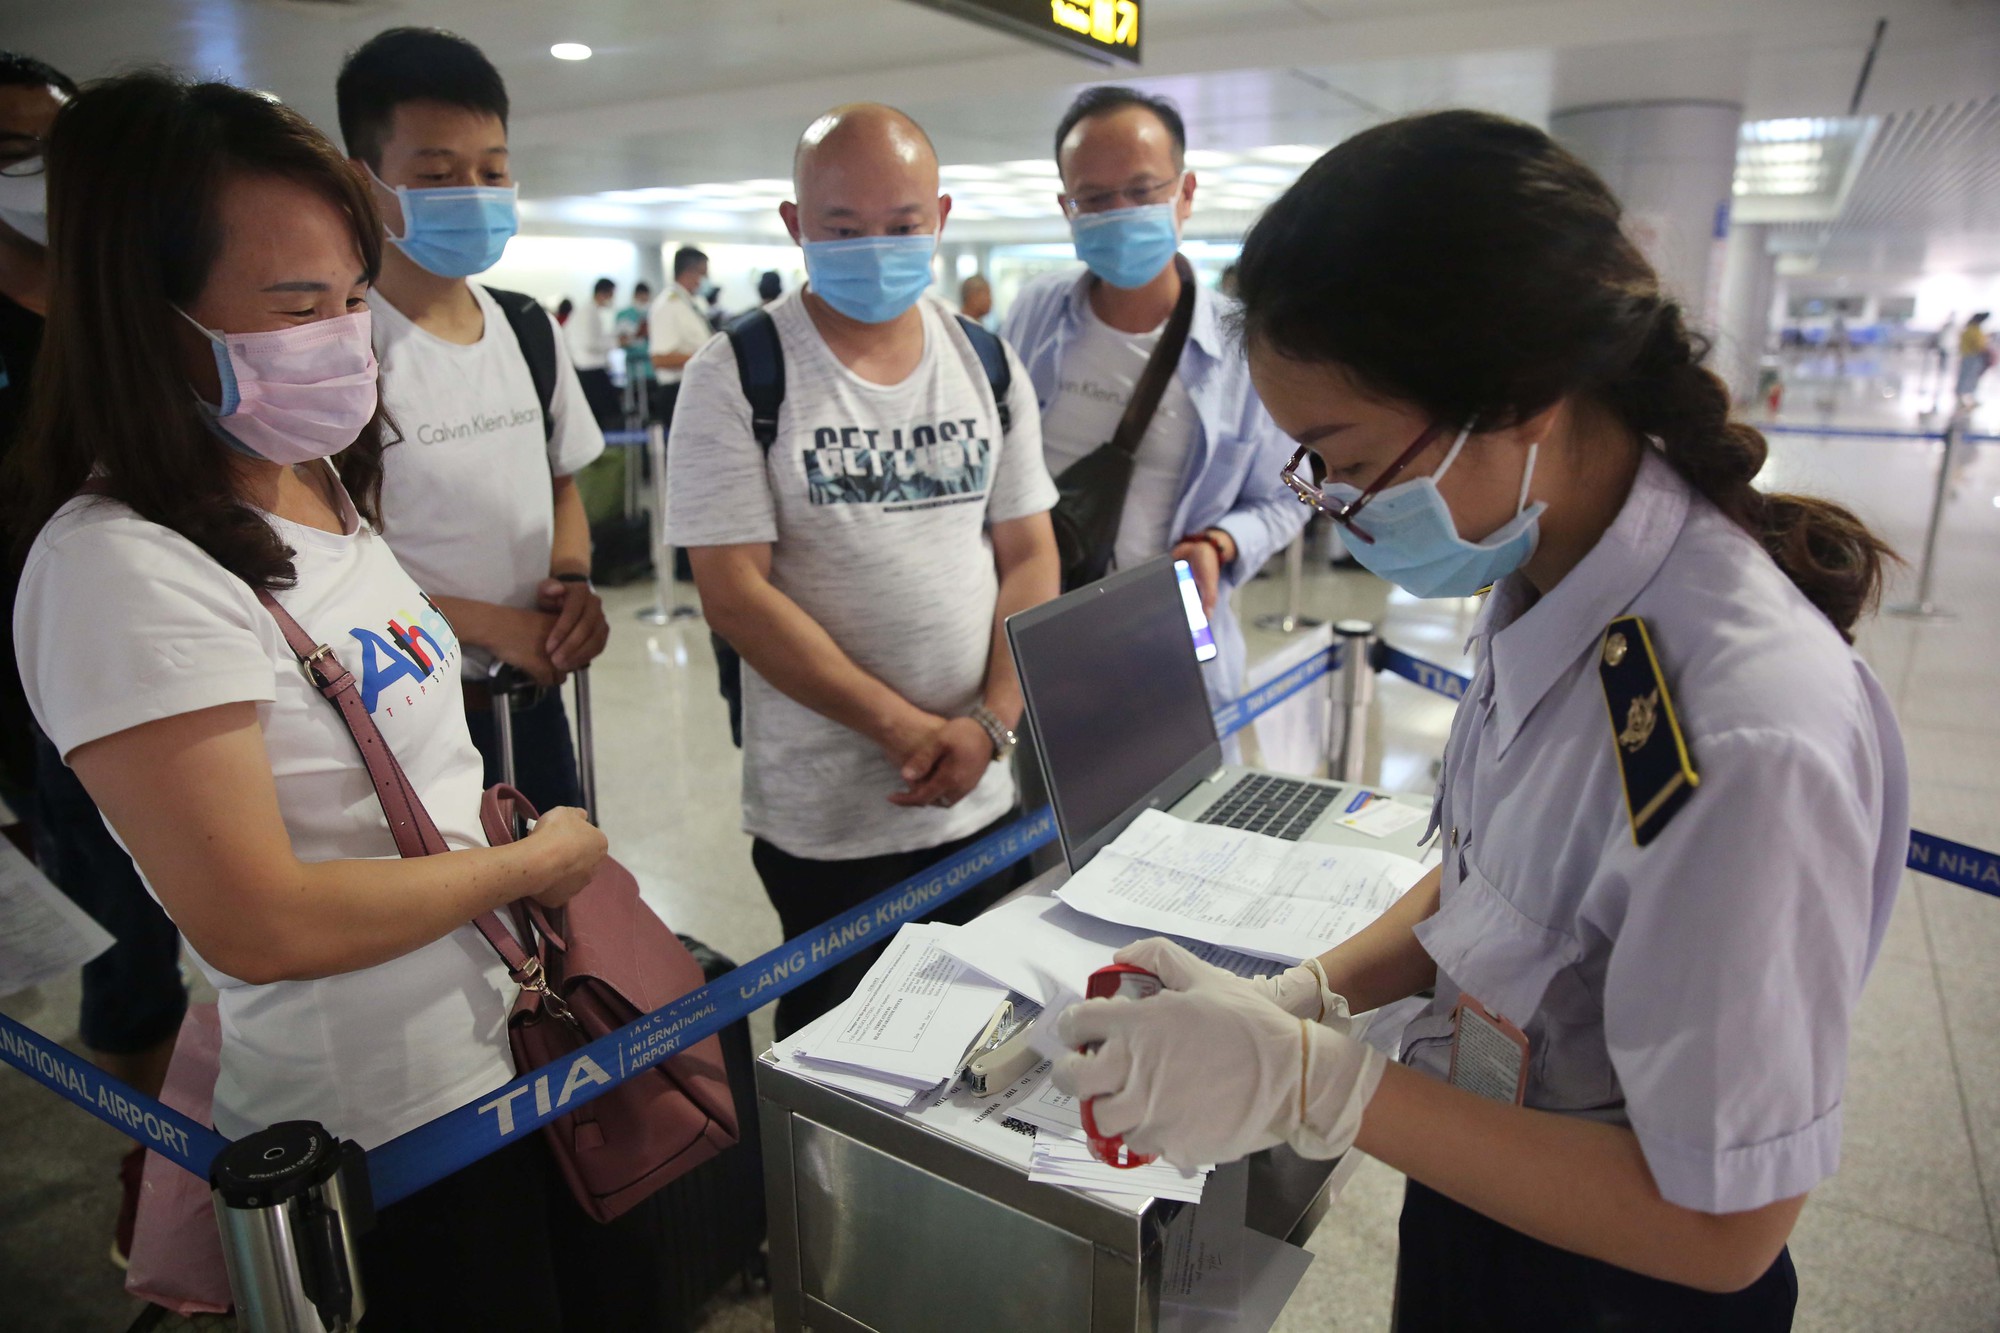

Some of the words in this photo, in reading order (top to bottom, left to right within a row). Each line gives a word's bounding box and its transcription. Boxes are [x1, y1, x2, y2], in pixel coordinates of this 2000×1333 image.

[417, 421, 471, 445] Calvin
[472, 413, 508, 435] Klein
[814, 426, 884, 478] GET
[893, 418, 982, 481] LOST
[1412, 661, 1466, 699] TIA
[629, 1002, 718, 1056] INTERNATIONAL
[631, 1033, 682, 1072] AIRPORT
[478, 1054, 613, 1137] TIA
[973, 1102, 1001, 1124] WEBSITE
[1003, 1088, 1018, 1099] THE
[98, 1085, 189, 1157] AIRPORT
